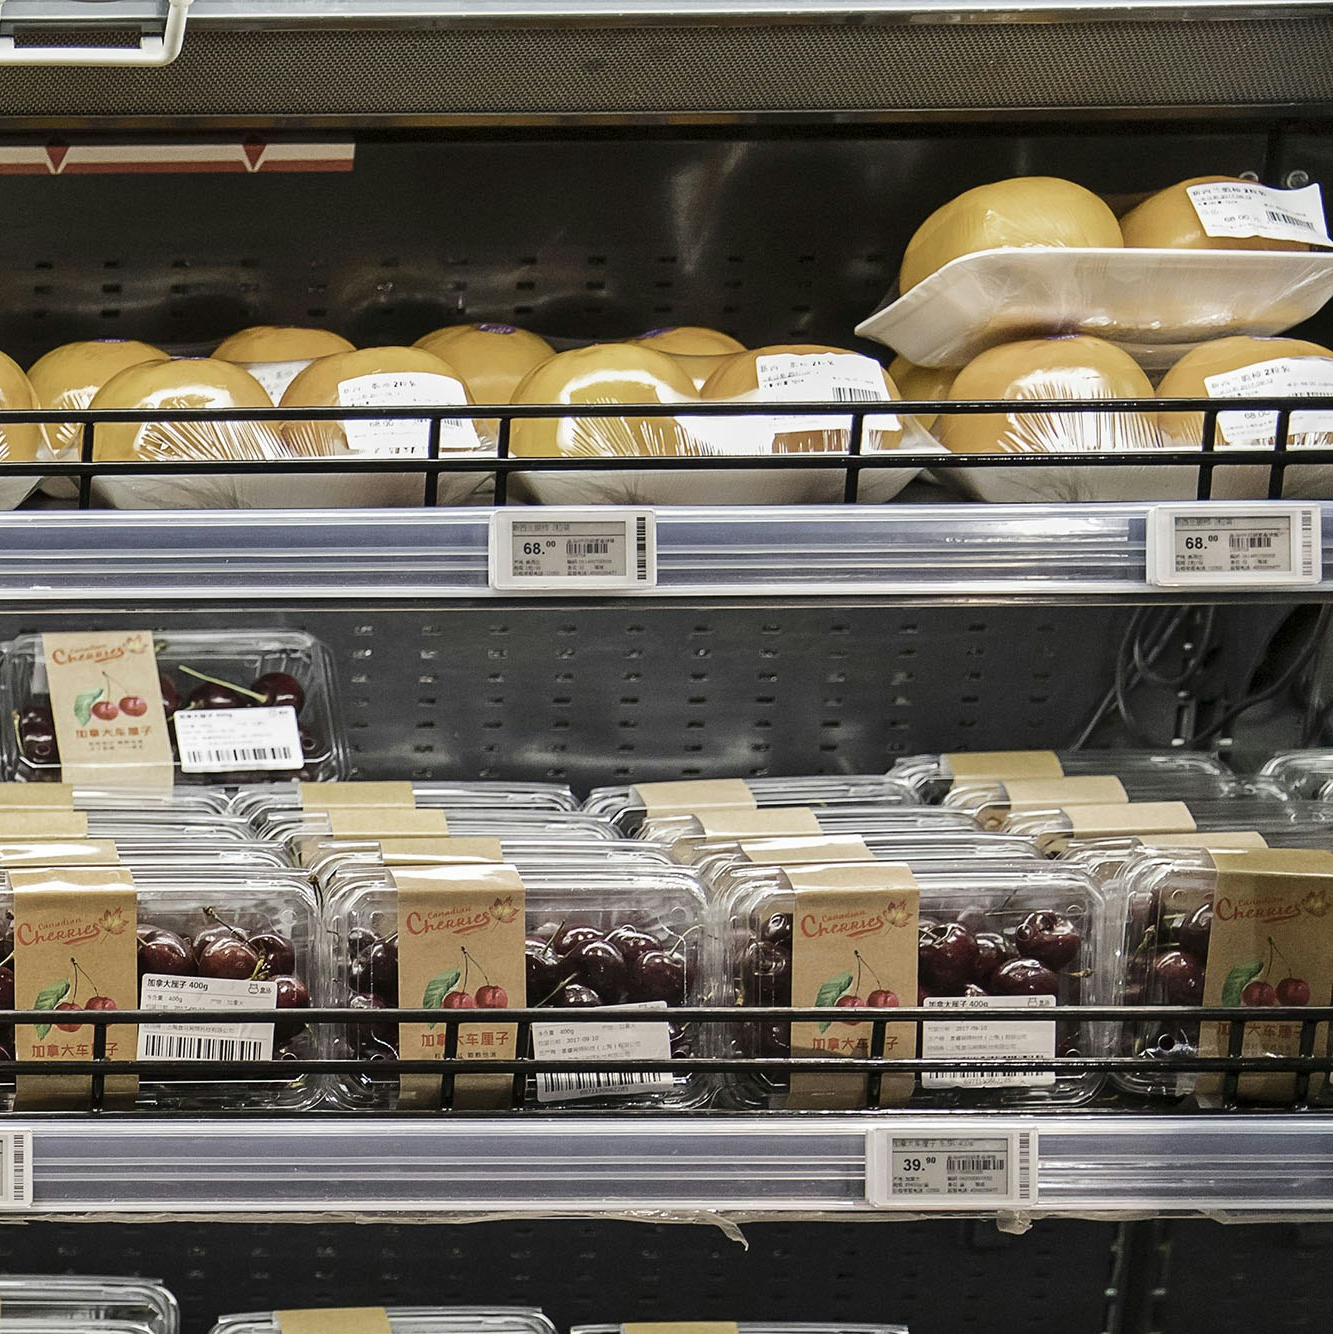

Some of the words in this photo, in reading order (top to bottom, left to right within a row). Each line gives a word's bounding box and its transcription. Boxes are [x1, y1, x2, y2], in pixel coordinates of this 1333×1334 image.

[523, 541, 556, 555] 68.00
[1186, 535, 1218, 550] 68.00
[428, 906, 471, 920] Canadian
[821, 909, 866, 922] Canadian
[1216, 897, 1302, 922] Cherries
[38, 917, 82, 930] Canadian
[407, 911, 489, 937] Cherries
[801, 915, 884, 938] Cherries
[17, 923, 100, 946] Cherries
[189, 982, 208, 991] 400g
[32, 1042, 118, 1058] 加拿大车子
[812, 1036, 898, 1051] 加拿大车子
[903, 1157, 936, 1171] 39.90
